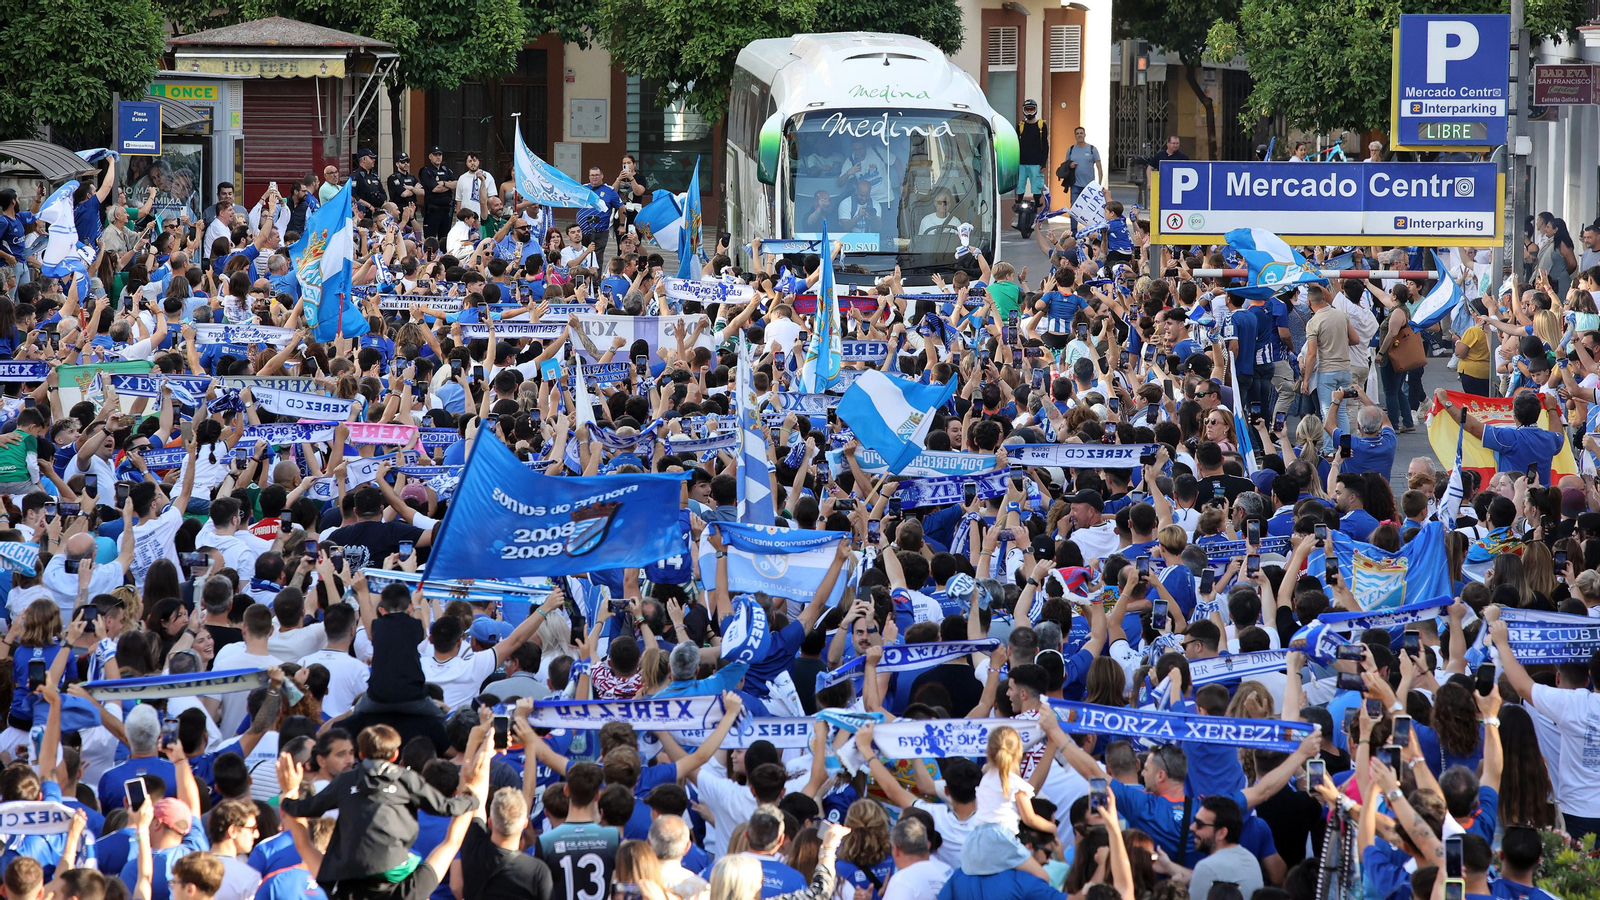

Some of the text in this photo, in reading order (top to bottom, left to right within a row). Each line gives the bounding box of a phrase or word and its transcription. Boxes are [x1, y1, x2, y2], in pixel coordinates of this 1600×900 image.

[1427, 20, 1480, 84] P
[222, 60, 299, 74] TIO PEPE
[1540, 68, 1589, 78] BAR EVA
[170, 86, 213, 98] ONCE
[1405, 86, 1457, 98] Mercado
[1424, 103, 1498, 116] Interparking
[1427, 123, 1472, 139] LIBRE
[1171, 167, 1199, 205] P
[1226, 171, 1358, 198] Mercado
[1409, 216, 1484, 232] Interparking
[856, 242, 878, 252] SAD
[567, 362, 606, 377] XREZ
[144, 455, 169, 465] EREZ
[550, 503, 571, 515] de
[513, 521, 577, 543] 2008
[774, 535, 833, 548] ABANDERANDO
[500, 542, 563, 560] 2009
[657, 553, 684, 570] 14
[1546, 628, 1592, 641] CLUB
[1193, 664, 1209, 677] ER
[1080, 710, 1176, 738] ¡FORZA
[1185, 720, 1281, 743] XEREZ!
[559, 852, 606, 900] 13
